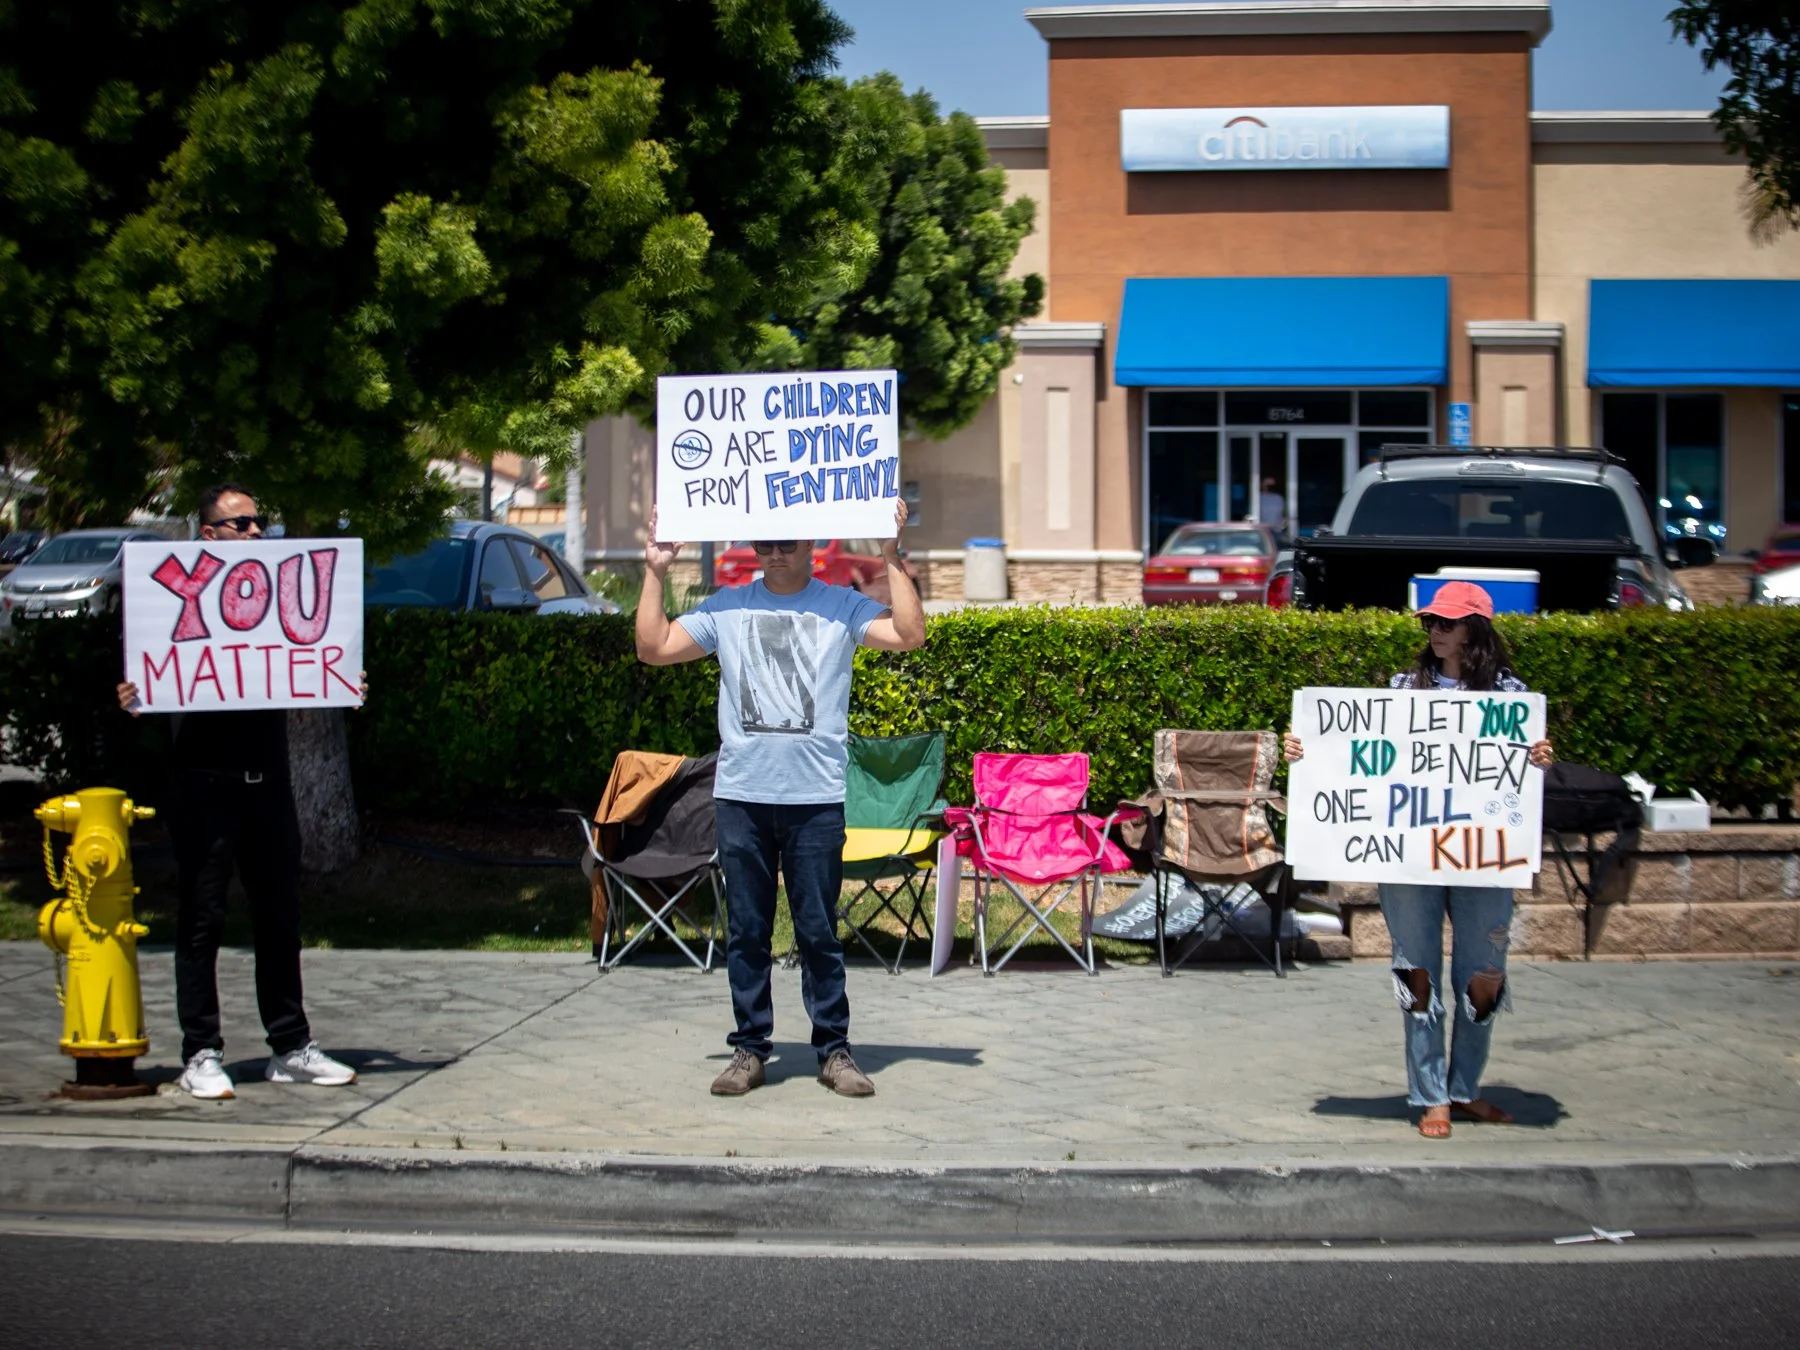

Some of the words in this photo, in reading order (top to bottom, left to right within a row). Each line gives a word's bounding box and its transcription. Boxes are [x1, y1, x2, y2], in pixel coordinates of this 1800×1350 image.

[1198, 118, 1372, 161] citibank
[684, 386, 746, 421] OUR
[764, 377, 892, 420] CHILDREN
[724, 430, 777, 467] ARE
[788, 423, 878, 465] DYING
[685, 469, 751, 514] FROM
[765, 456, 898, 510] FENTANYL
[150, 548, 338, 645] YOU
[143, 643, 360, 706] MATTER
[1317, 698, 1393, 735] DONT
[1409, 697, 1472, 735] LET
[1477, 697, 1530, 743] YOUR
[1350, 739, 1398, 778] KID
[1411, 741, 1444, 775] BE
[1448, 740, 1533, 794] NEXT
[1313, 788, 1372, 824] ONE
[1387, 783, 1472, 828] PILL
[1344, 833, 1404, 863] CAN
[1430, 826, 1529, 872] KILL
